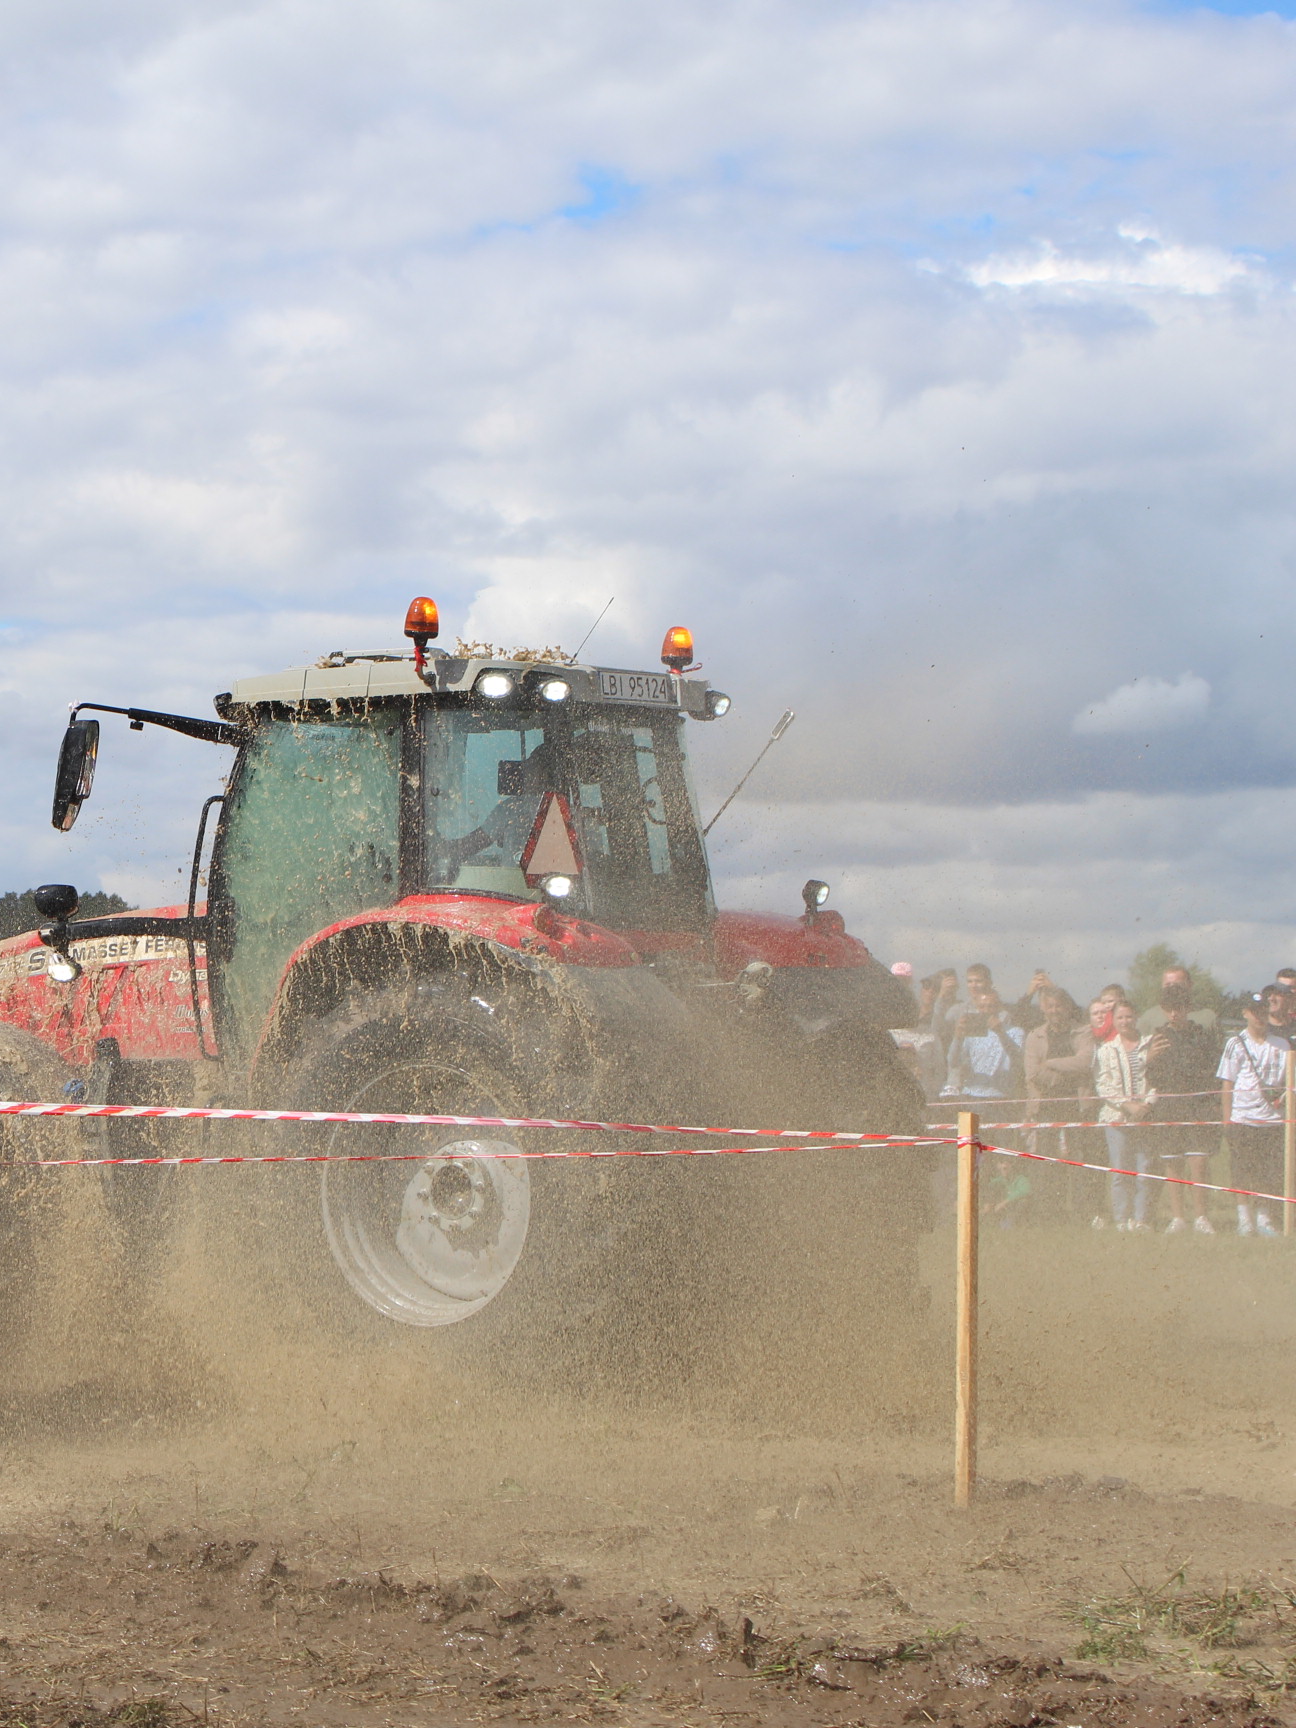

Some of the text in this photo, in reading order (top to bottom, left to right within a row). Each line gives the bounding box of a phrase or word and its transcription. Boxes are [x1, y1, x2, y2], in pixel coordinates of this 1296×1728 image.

[601, 674, 667, 699] LBI 95124
[72, 938, 140, 962] MASSEY
